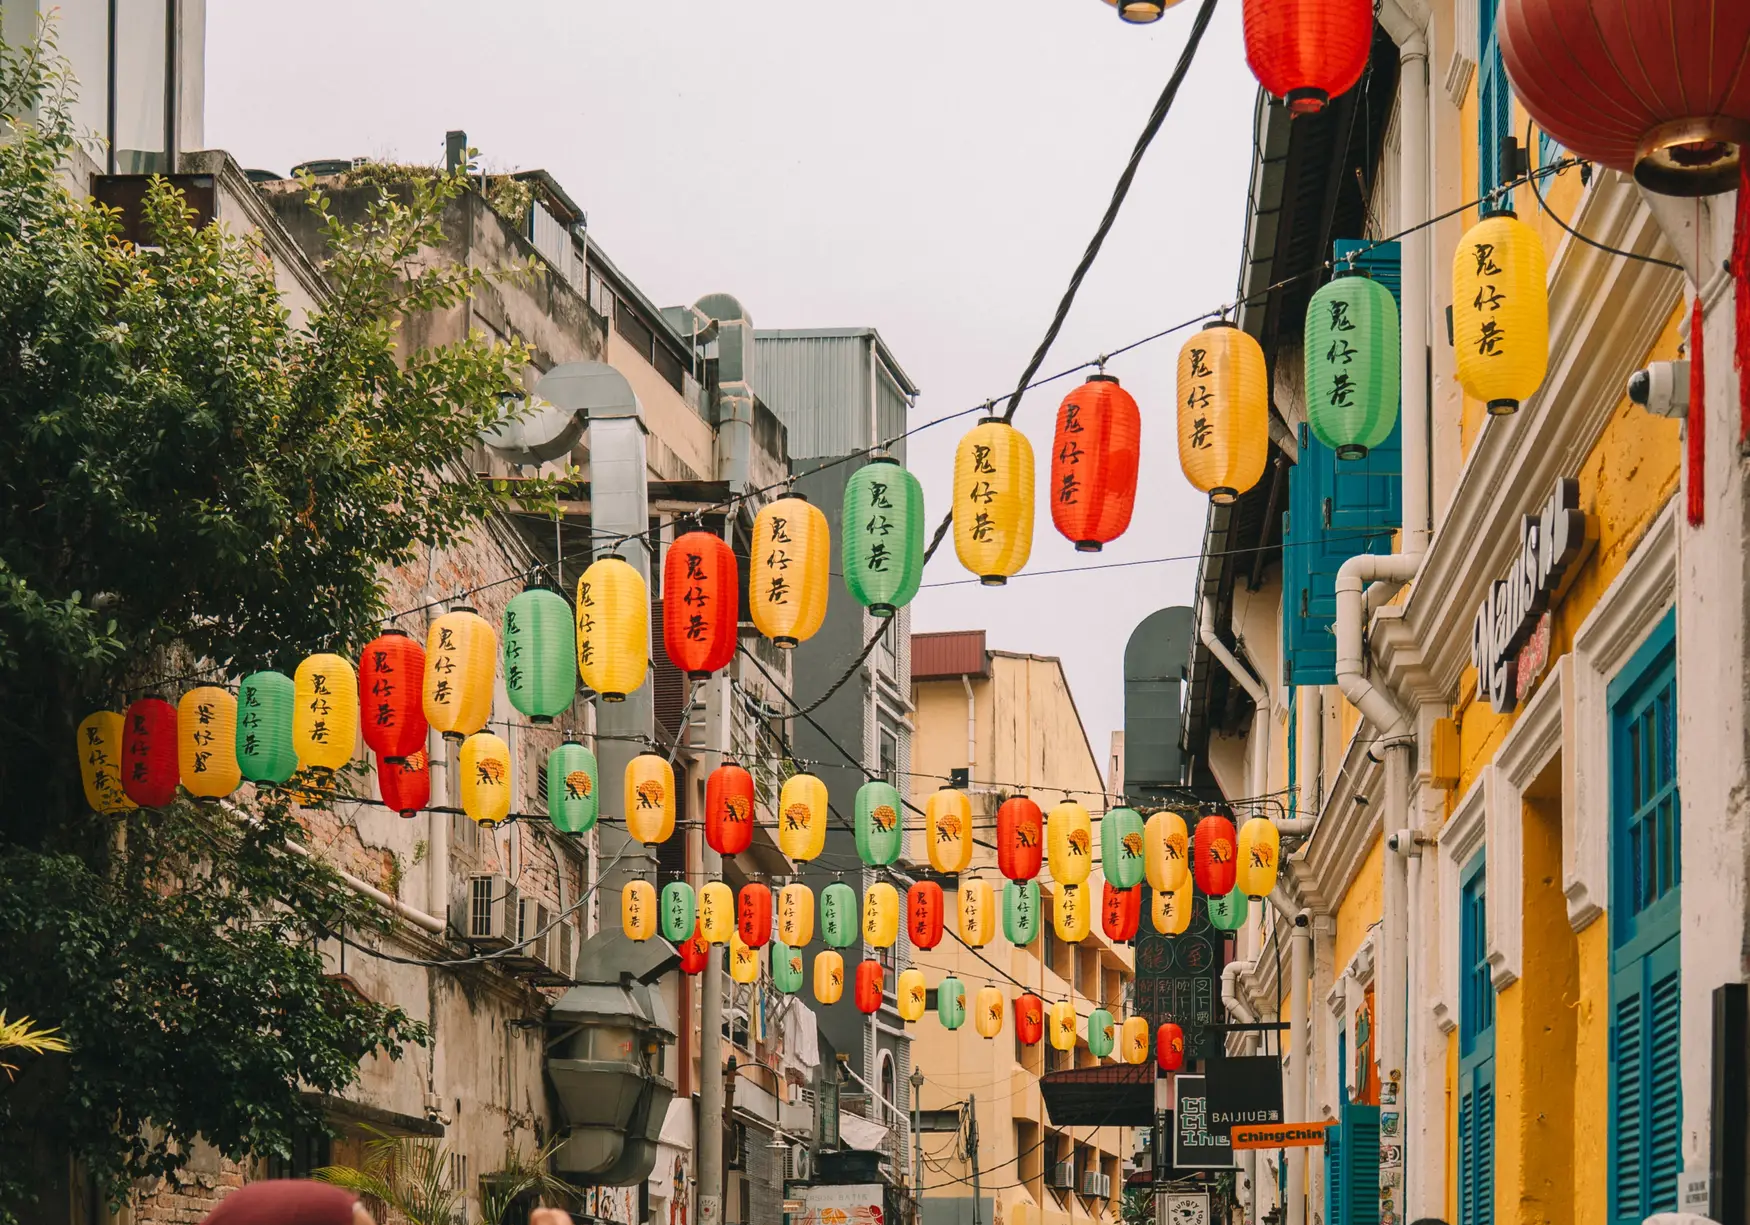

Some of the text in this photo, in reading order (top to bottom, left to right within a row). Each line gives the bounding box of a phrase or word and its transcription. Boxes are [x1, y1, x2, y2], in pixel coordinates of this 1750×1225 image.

[1473, 243, 1506, 356] 鬼仔巷
[1326, 300, 1359, 408] 鬼仔巷
[1188, 349, 1214, 450] 鬼仔巷
[1059, 403, 1085, 505] 鬼仔巷
[866, 481, 894, 572] 鬼仔巷
[969, 444, 998, 543] 鬼仔巷
[766, 516, 793, 605] 鬼仔巷
[577, 581, 596, 667] 鬼仔巷
[683, 553, 711, 641] 鬼仔巷
[434, 627, 457, 704] 鬼仔巷
[504, 611, 525, 691] 鬼仔巷
[242, 686, 260, 756] 鬼仔巷
[309, 673, 332, 745] 鬼仔巷
[372, 651, 396, 727] 鬼仔巷
[129, 714, 151, 783] 鬼仔巷
[630, 891, 640, 926] 鬼仔巷
[672, 893, 683, 928] 鬼仔巷
[705, 894, 714, 929] 鬼仔巷
[744, 895, 754, 933] 鬼仔巷
[784, 894, 795, 931] 鬼仔巷
[826, 895, 837, 933] 鬼仔巷
[869, 894, 878, 931] 鬼仔巷
[916, 893, 928, 934] 鬼仔巷
[967, 892, 978, 932] 鬼仔巷
[1017, 887, 1031, 930] 鬼仔巷
[1171, 1200, 1200, 1214] hungry
